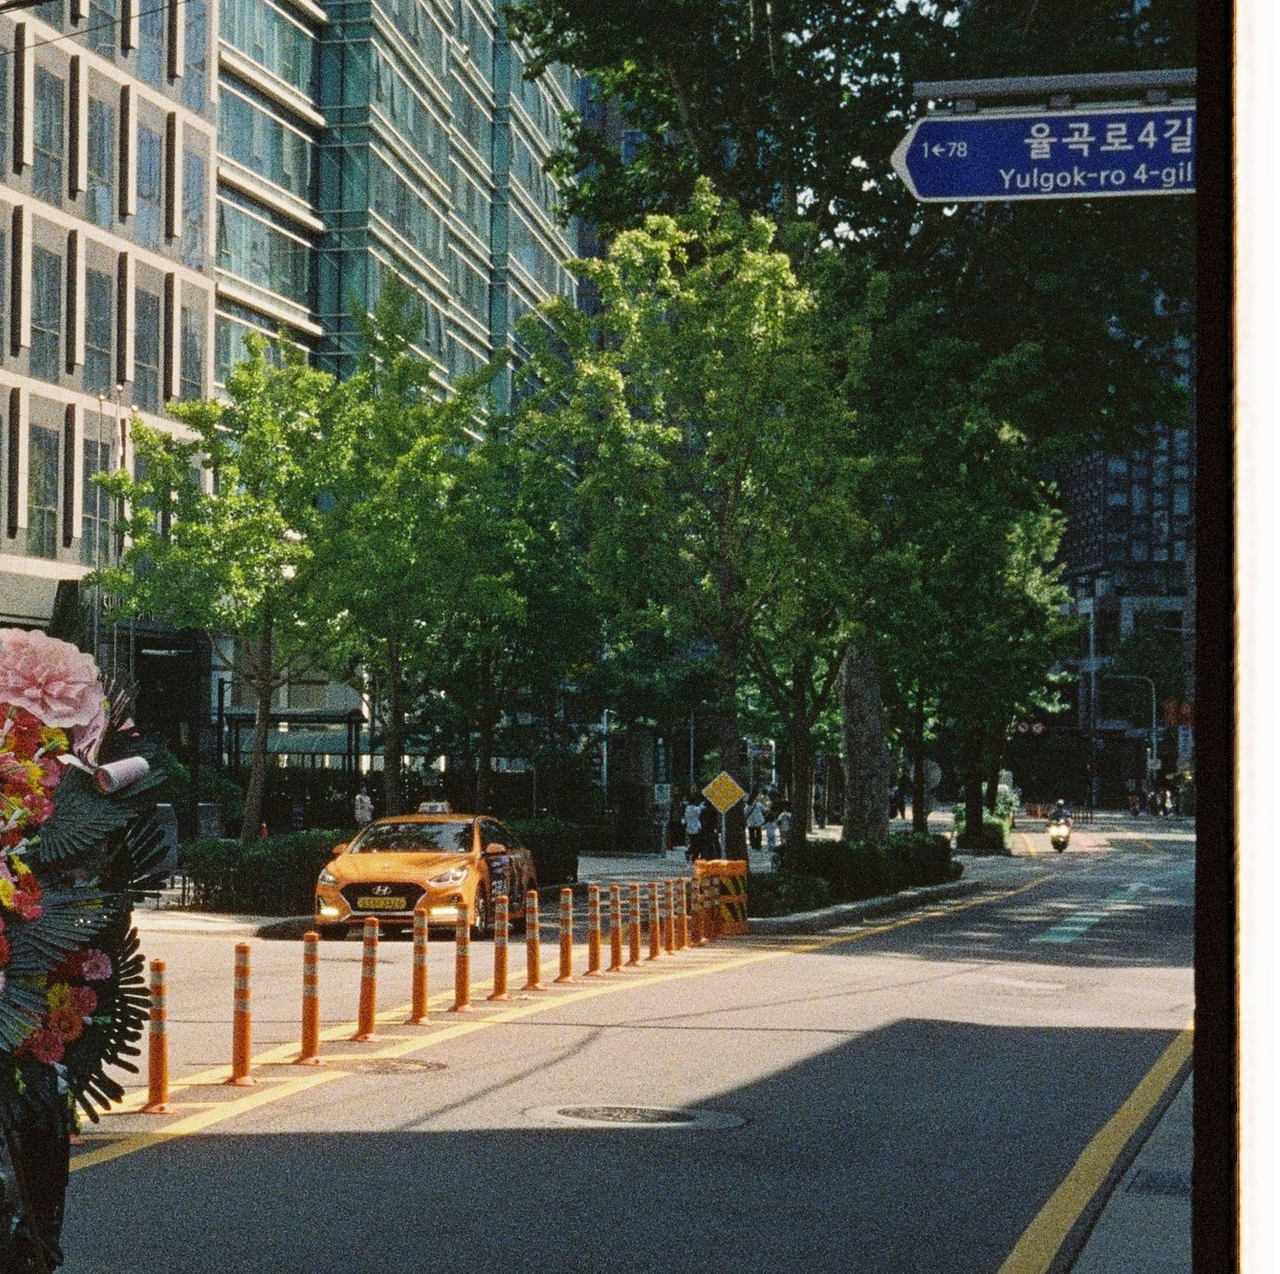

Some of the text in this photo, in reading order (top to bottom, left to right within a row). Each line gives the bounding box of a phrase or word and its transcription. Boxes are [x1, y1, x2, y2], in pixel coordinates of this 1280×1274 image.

[947, 141, 968, 158] 78
[1023, 117, 1193, 160] 율곡로4길
[999, 161, 1193, 192] Yulgok-ro 4-gil
